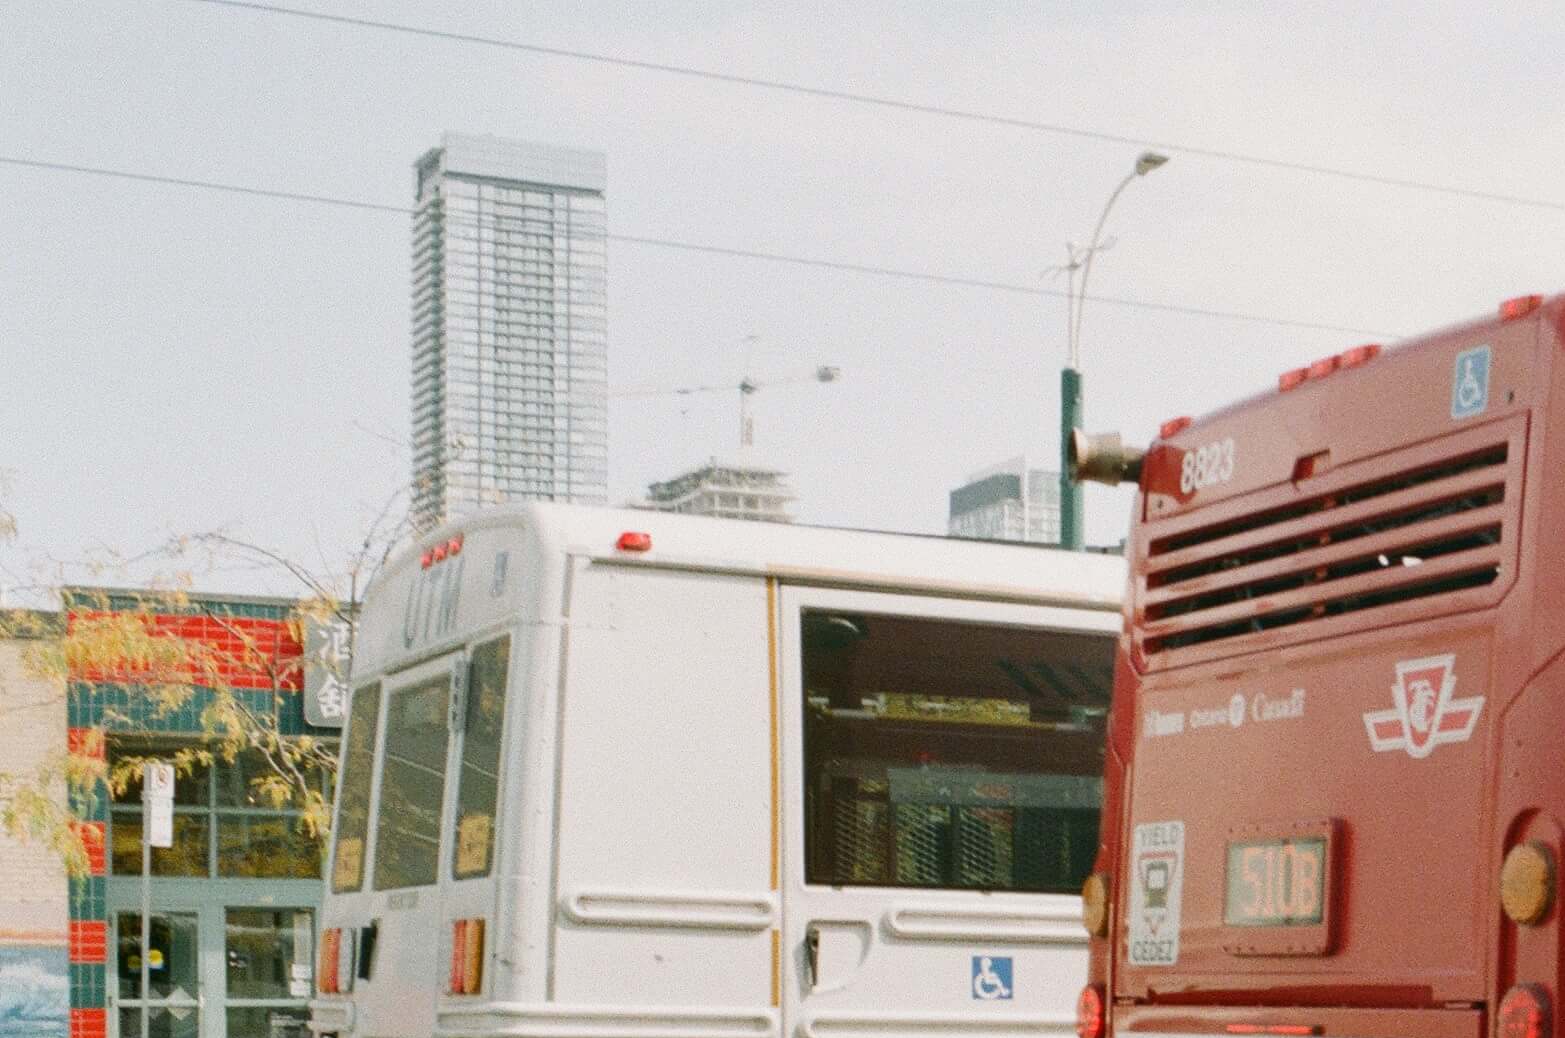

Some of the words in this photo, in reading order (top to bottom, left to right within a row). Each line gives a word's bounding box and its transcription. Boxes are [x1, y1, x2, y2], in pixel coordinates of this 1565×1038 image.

[1181, 438, 1233, 494] 8823
[1141, 824, 1180, 848] YIELD
[1242, 844, 1319, 917] 510B
